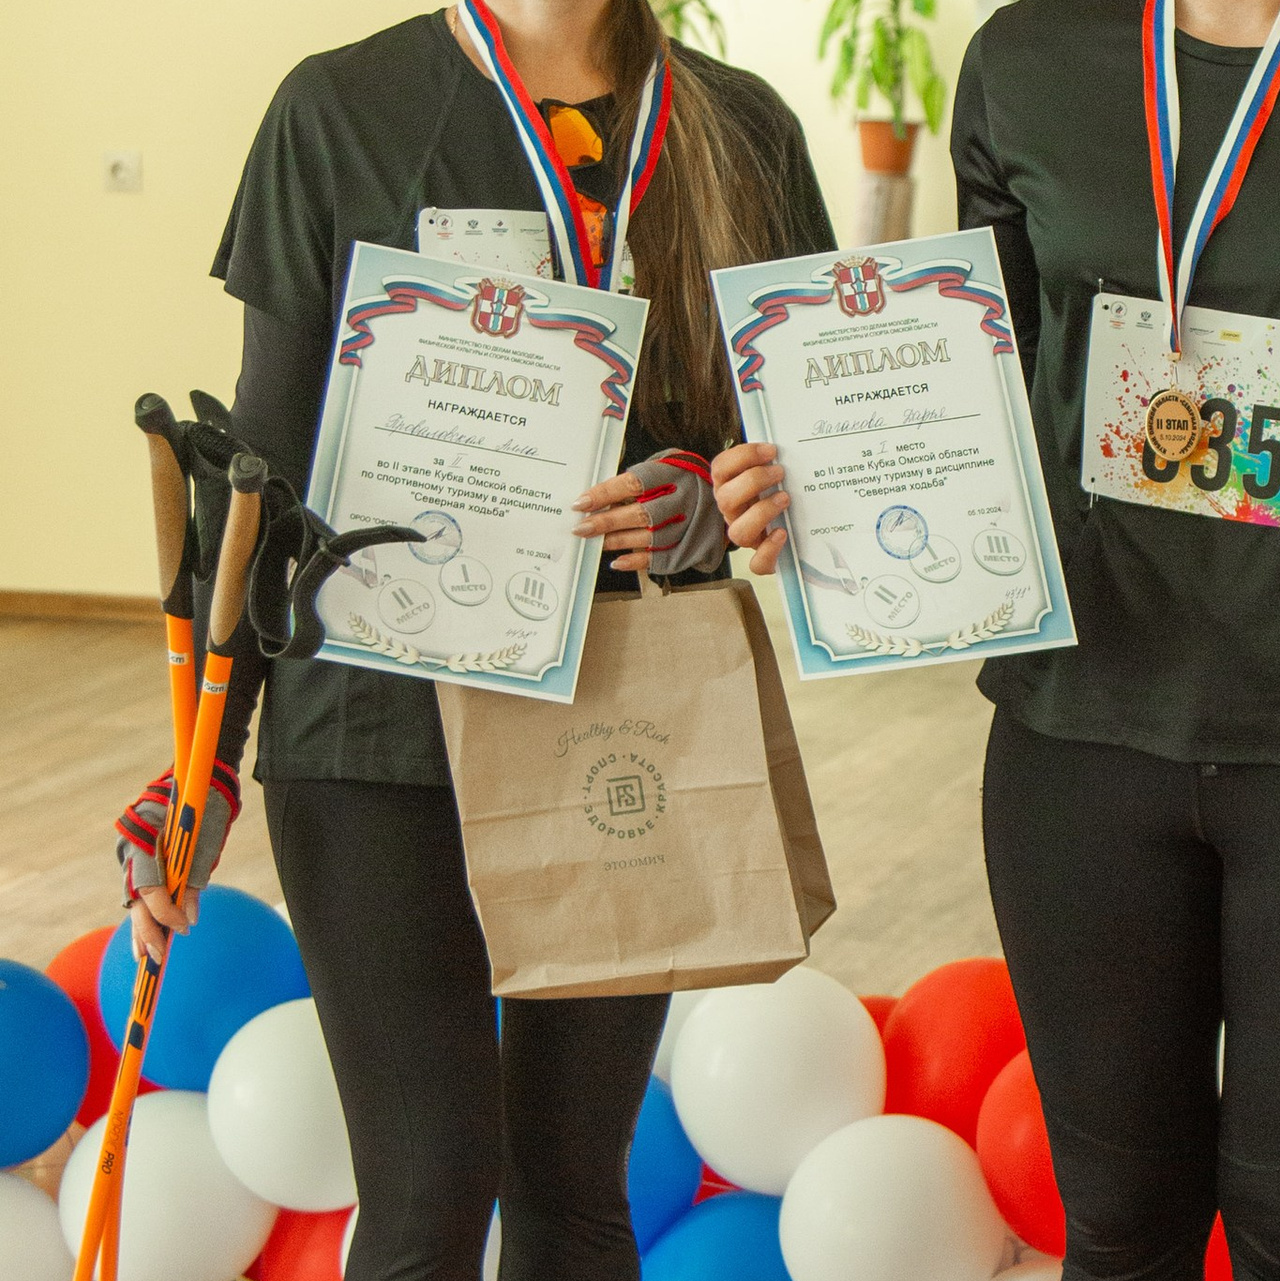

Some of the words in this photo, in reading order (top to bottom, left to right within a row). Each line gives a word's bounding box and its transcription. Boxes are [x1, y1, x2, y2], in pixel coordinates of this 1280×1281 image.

[803, 336, 837, 347] ФИЗИЧЕСКОЙ
[838, 333, 864, 342] КУЛЬТУРЫ
[869, 329, 889, 338] СПОРТА
[890, 325, 913, 334] ОМСКОЙ
[913, 322, 938, 331] ОБЛАСТИ
[818, 327, 859, 337] МИНИСТЕРСТВО
[868, 322, 887, 331] ДЕЛАМ
[418, 338, 455, 350] ФИЗИЧЕСКОЙ
[456, 346, 483, 356] КУЛЬТУРЫ
[489, 352, 510, 361] СПОРТА
[511, 356, 534, 366] ОМСКОЙ
[535, 361, 561, 371] ОБЛАСТИ
[438, 334, 482, 349] МИНИСТЕРСТВО
[483, 343, 491, 351] ПО
[491, 345, 511, 355] ДЕЛАМ
[804, 338, 951, 388] ДИПЛОМ
[405, 354, 563, 407] ДИПЛОМ
[835, 383, 929, 405] НАГРАЖДАЕТСЯ
[427, 399, 527, 427] НАГРАЖДАЕТСЯ
[1156, 419, 1163, 430] II
[1166, 419, 1188, 430] ЭТАП
[861, 449, 872, 458] за
[896, 441, 926, 453] место
[433, 457, 445, 466] за
[469, 464, 501, 477] место
[814, 469, 826, 478] во
[828, 467, 835, 476] II
[837, 464, 865, 475] этапе
[867, 458, 895, 472] Кубка
[898, 452, 936, 465] Омской
[939, 447, 979, 460] области
[377, 459, 389, 468] во
[392, 461, 399, 470] II
[402, 465, 431, 477] этапе
[434, 470, 464, 484] Кубка
[467, 476, 506, 491] Омской
[509, 484, 552, 500] области
[804, 483, 816, 493] по
[818, 474, 882, 490] спортивному
[884, 467, 924, 482] туризму
[927, 467, 933, 475] в
[935, 457, 995, 474] дисциплине
[361, 470, 374, 479] по
[377, 473, 444, 494] спортивному
[447, 486, 489, 503] туризму
[491, 495, 498, 503] в
[500, 497, 562, 515] дисциплине
[854, 483, 907, 498] "Северная
[909, 477, 948, 492] ходьба"
[410, 491, 465, 510] "Северная
[468, 503, 510, 519] ходьба"
[967, 506, 1002, 516] 05.10.2024
[350, 513, 371, 523] ОРОО
[810, 527, 831, 536] ОРОО
[516, 548, 551, 559] 05.10.2024
[986, 535, 1010, 554] III
[923, 555, 956, 574] МЕСТО
[983, 554, 1020, 563] МЕСТО
[461, 564, 470, 583] I
[392, 587, 414, 610] II
[451, 584, 486, 592] МЕСТО
[523, 577, 545, 600] III
[874, 585, 898, 606] II
[396, 602, 430, 624] МЕСТО
[514, 593, 549, 611] МЕСТО
[887, 590, 914, 622] МЕСТО
[554, 722, 615, 757] Healthy
[618, 720, 633, 735] &
[633, 720, 671, 746] Rich
[582, 753, 617, 794] СПОРТ
[630, 752, 667, 813] КРАСОТА
[584, 805, 655, 839] ЗДОРОВЬЕ
